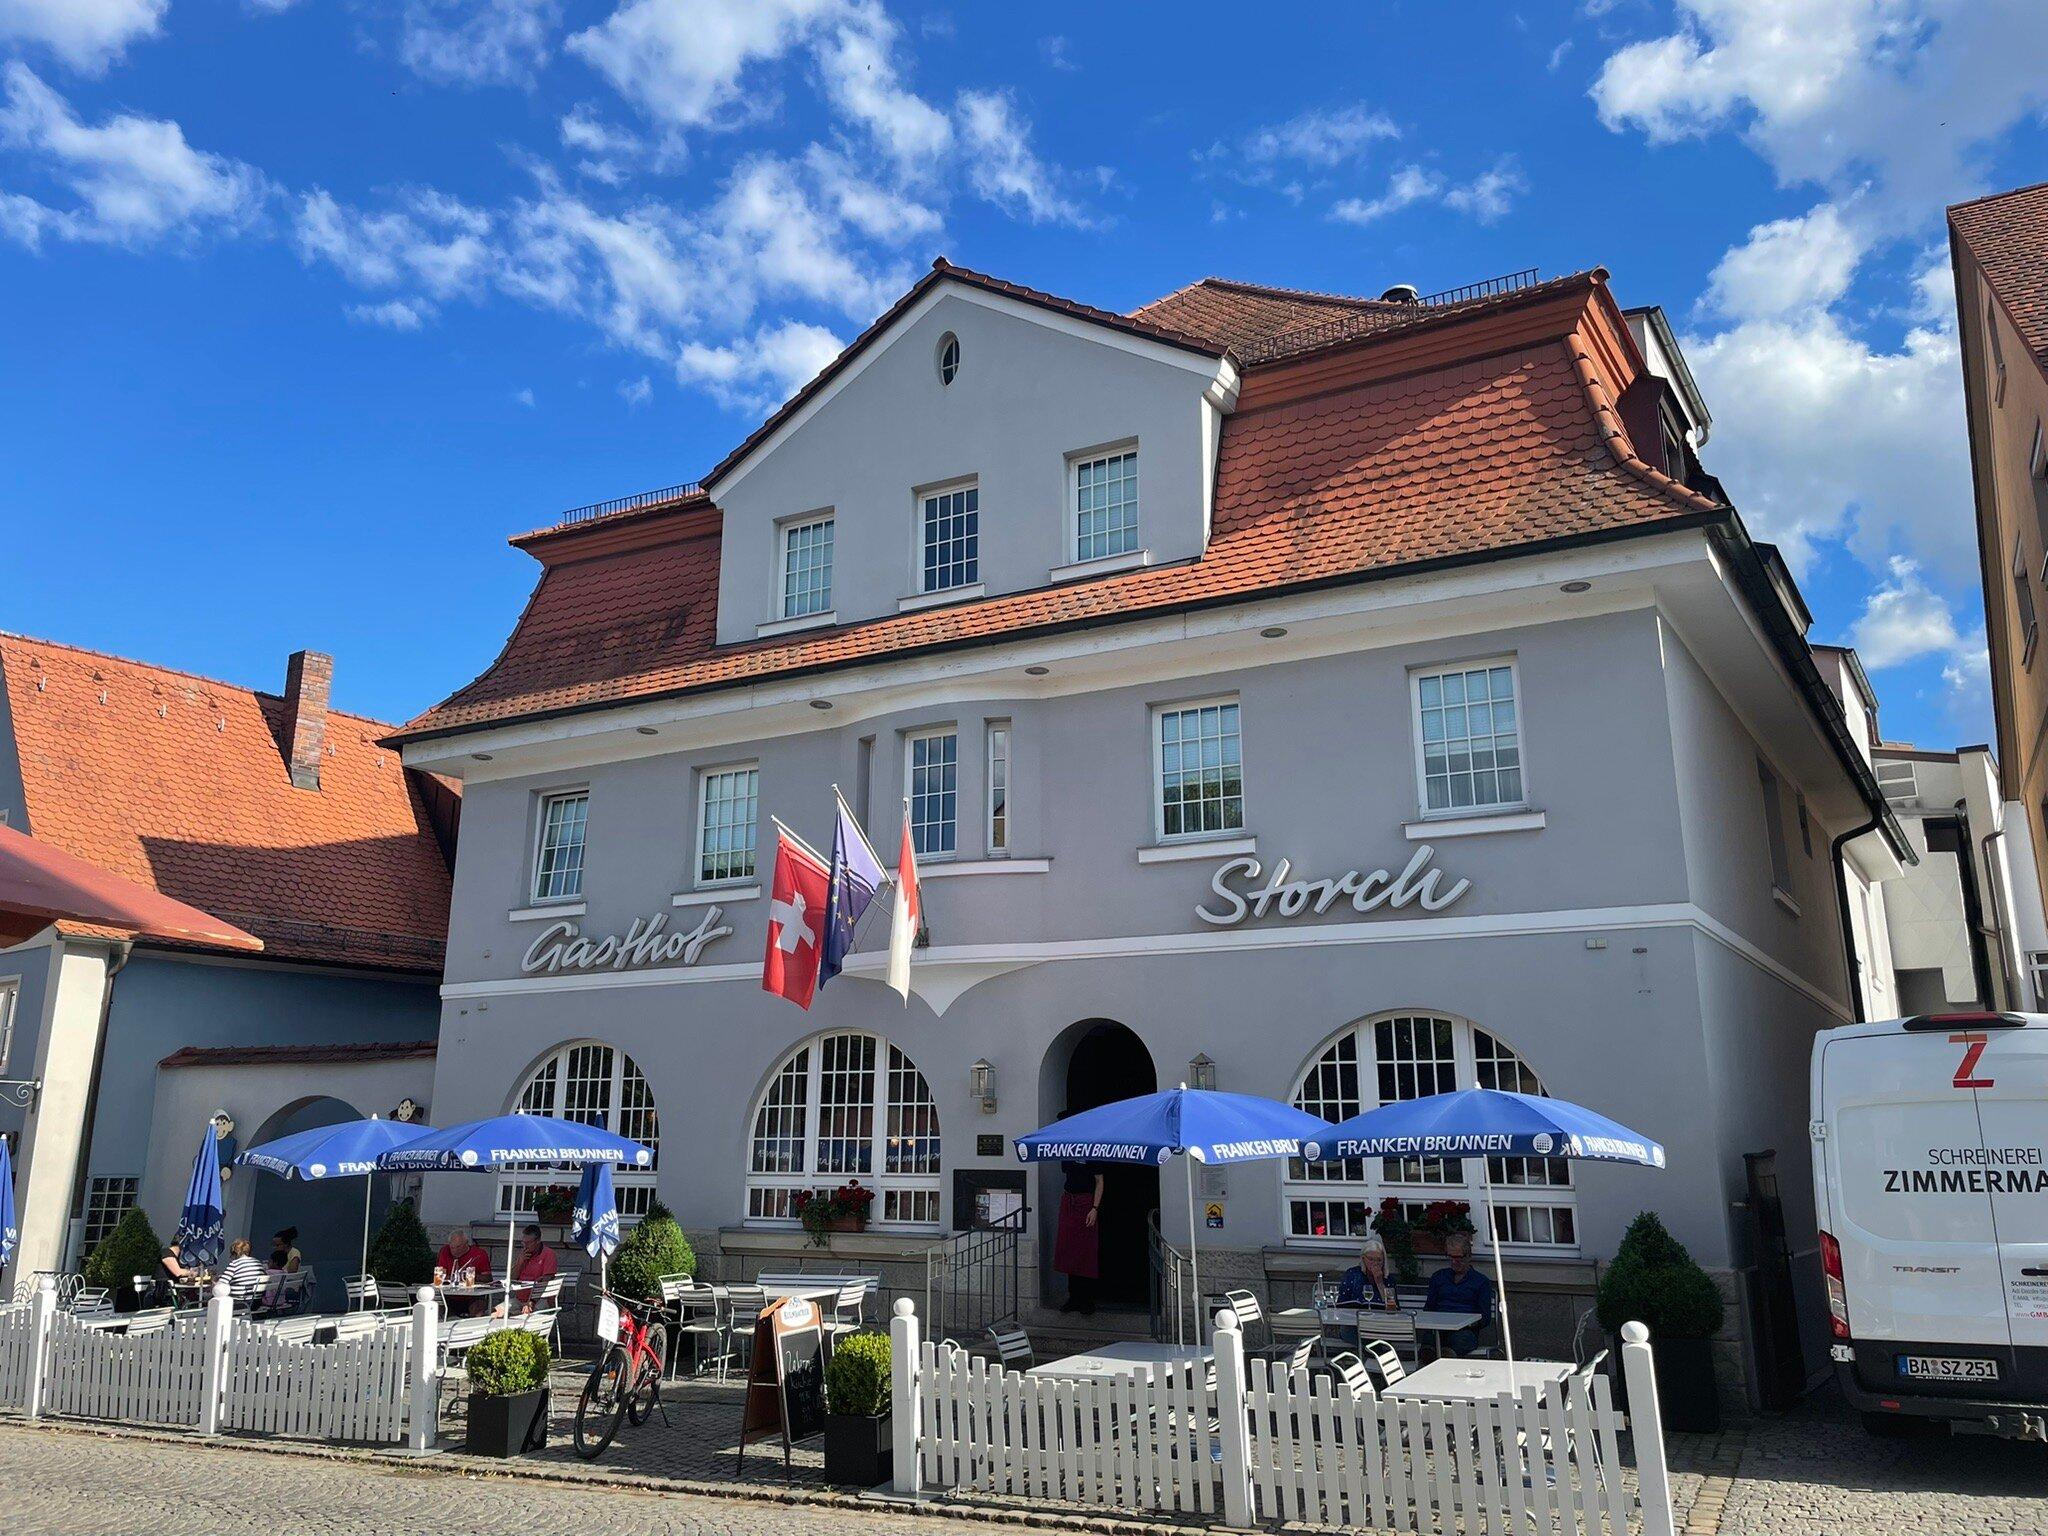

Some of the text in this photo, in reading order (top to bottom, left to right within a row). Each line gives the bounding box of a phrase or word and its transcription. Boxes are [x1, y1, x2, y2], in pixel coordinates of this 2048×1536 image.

[521, 844, 1473, 972] Gasthof Storch
[1949, 1034, 1994, 1088] Z
[490, 1148, 624, 1160] FRANKEN BRUNNEN
[1037, 1143, 1148, 1160] FRANKEN BRUNNEN
[1212, 1139, 1300, 1159] FRANKEN BRU
[1337, 1134, 1513, 1156] FRANKEN BRUNNEN
[1928, 1148, 2043, 1165] SCHREINEREI
[1908, 1359, 1997, 1377] BA SZ 251
